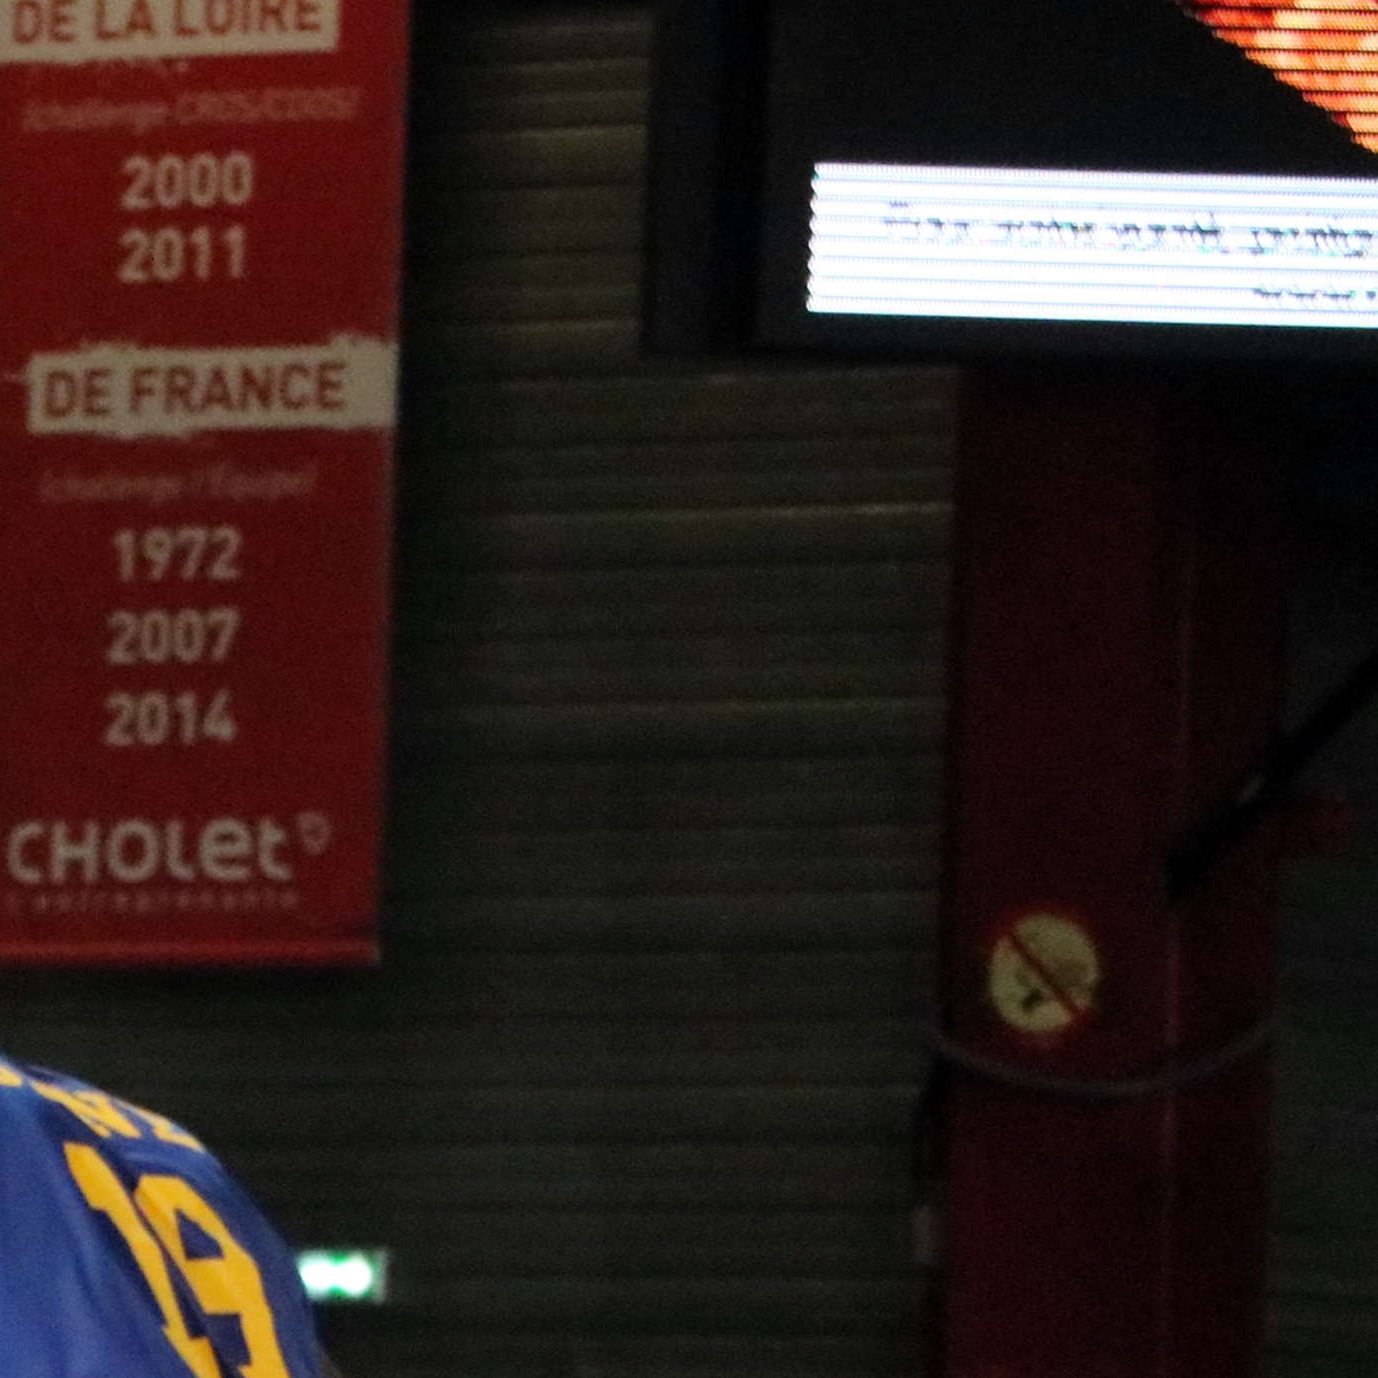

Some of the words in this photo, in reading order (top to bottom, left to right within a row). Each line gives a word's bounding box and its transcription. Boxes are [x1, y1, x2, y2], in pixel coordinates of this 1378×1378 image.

[12, 0, 75, 45] DE
[94, 0, 156, 41] LA
[118, 150, 254, 212] 2000
[116, 225, 246, 284] 2011
[44, 368, 112, 419] DE
[129, 360, 346, 415] FRANCE
[112, 524, 242, 583] 1972
[105, 606, 241, 666] 2007
[104, 688, 238, 747] 2014
